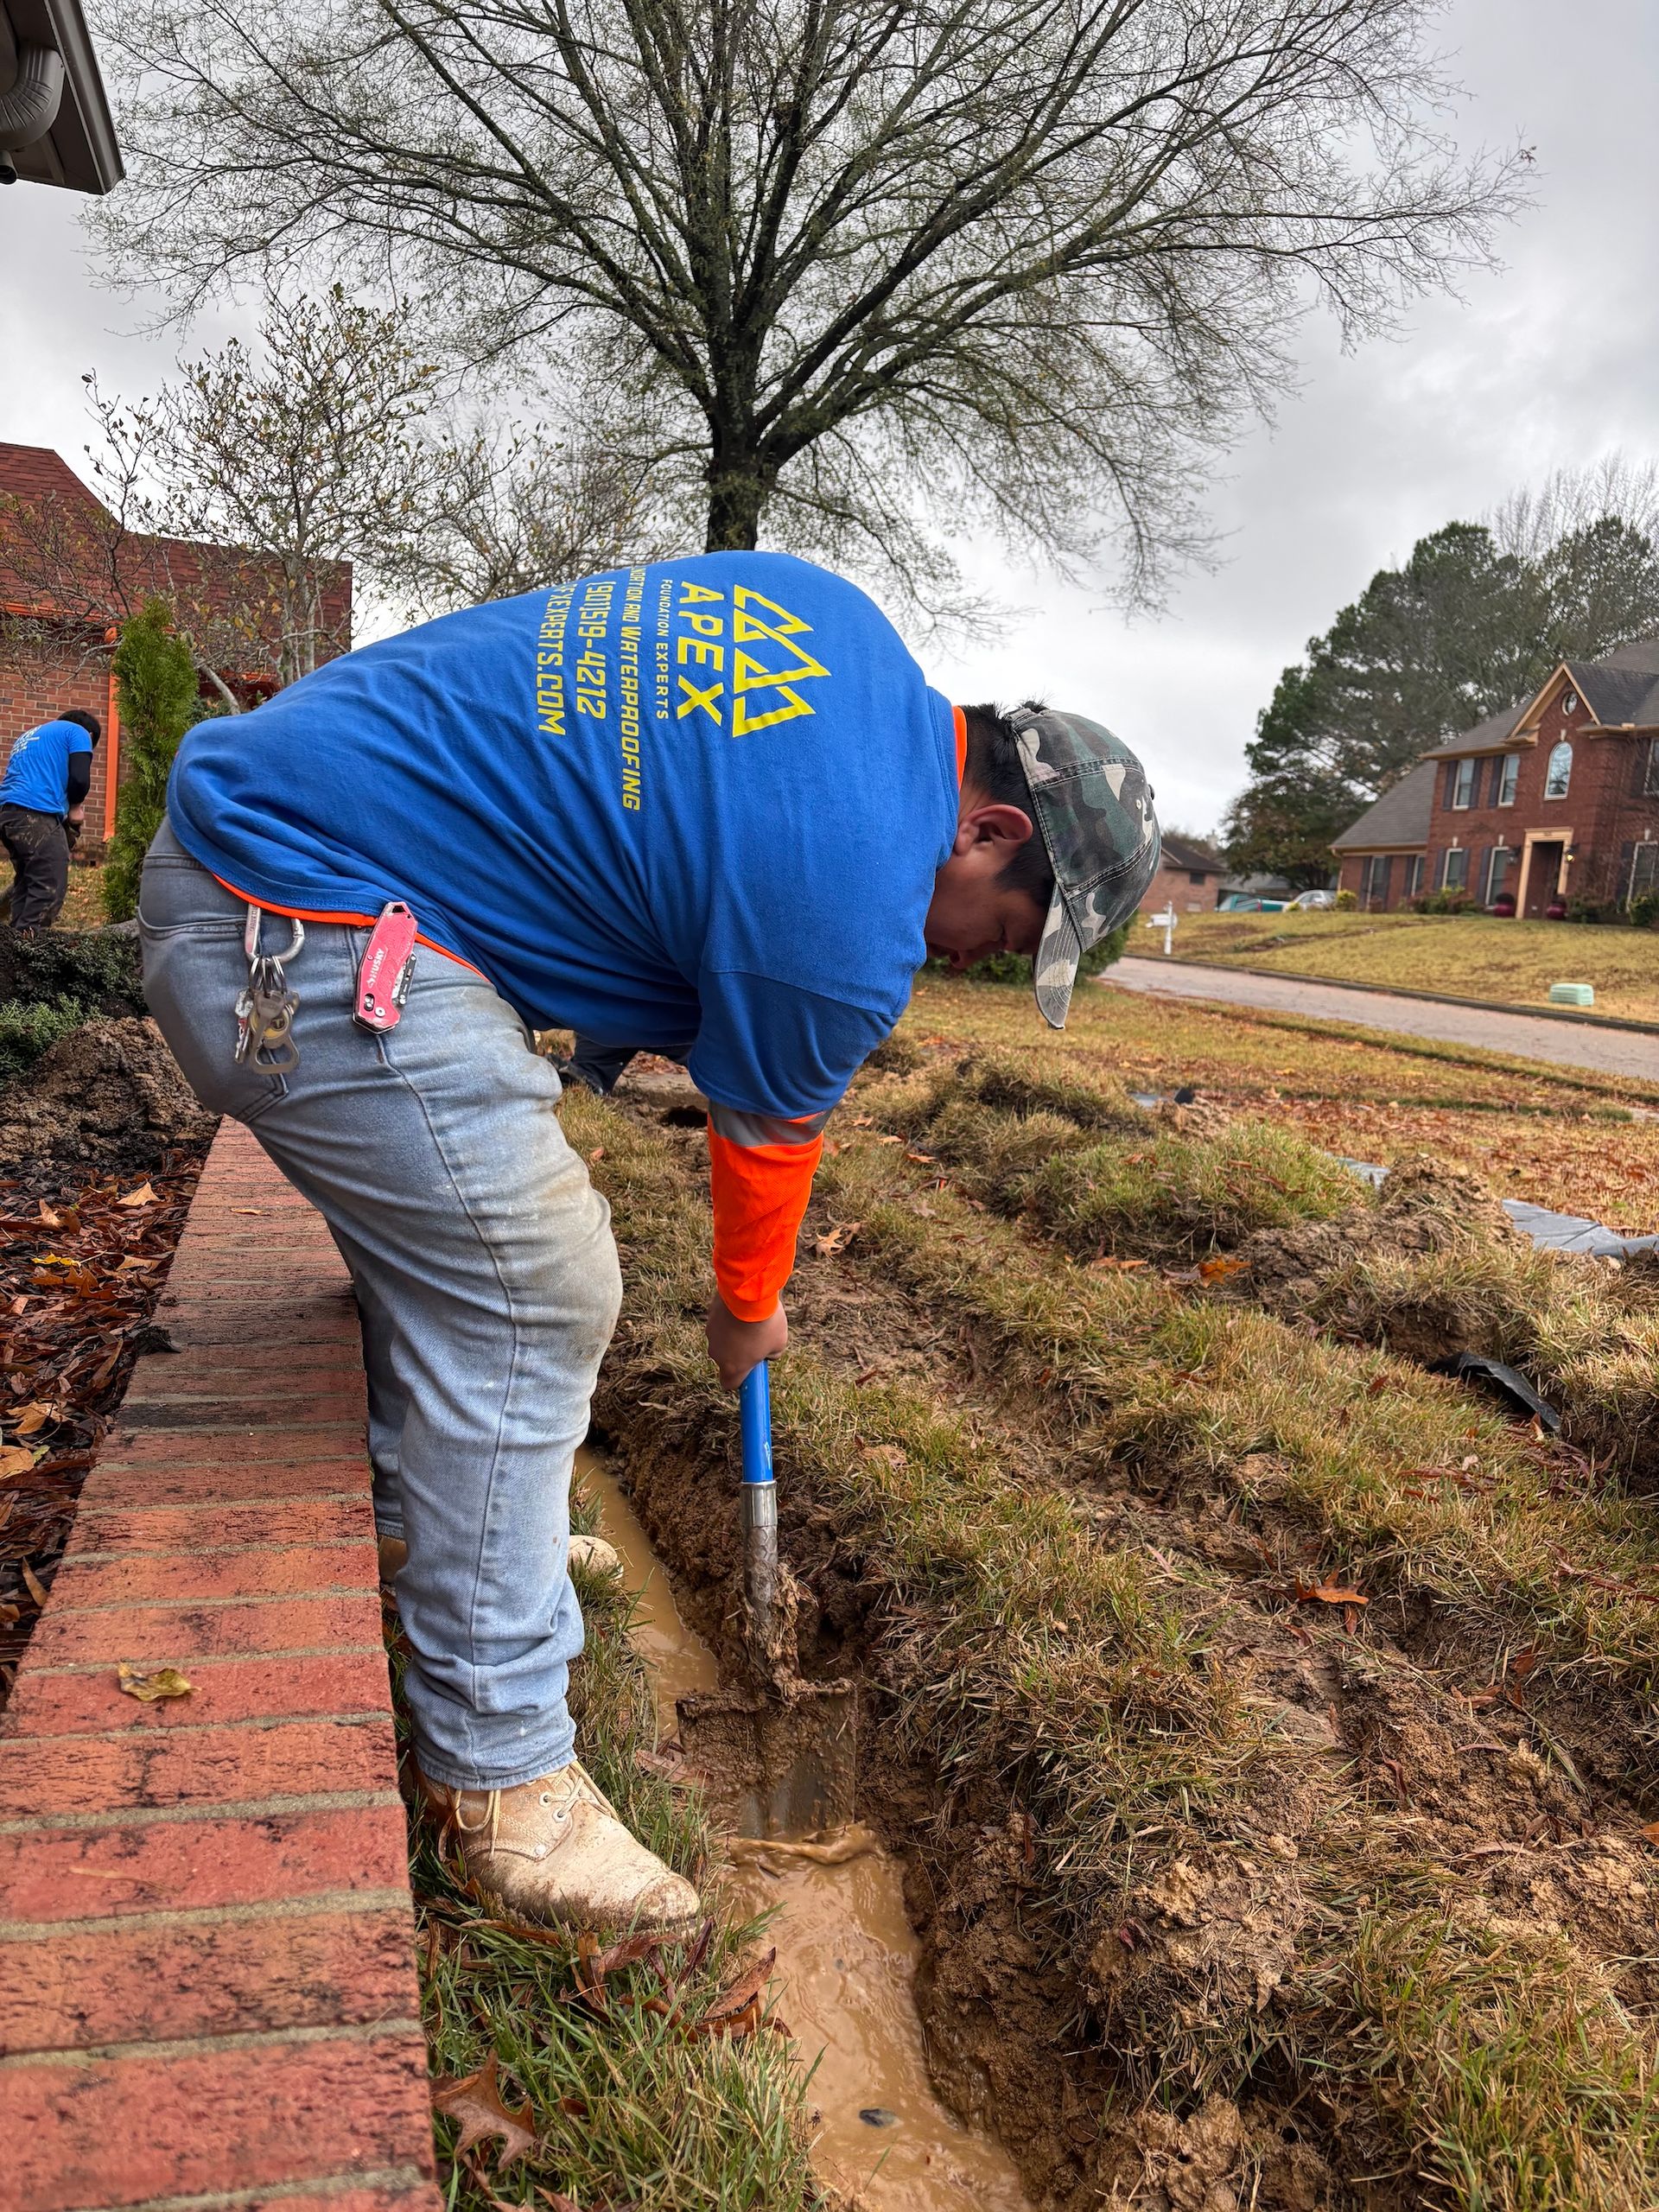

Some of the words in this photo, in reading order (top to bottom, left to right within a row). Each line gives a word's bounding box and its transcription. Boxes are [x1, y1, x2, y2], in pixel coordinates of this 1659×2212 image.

[576, 581, 617, 720] (901)519-4212
[657, 579, 673, 637] FOUNDATION
[677, 581, 725, 727] APEX
[656, 642, 669, 720] EXPERTS
